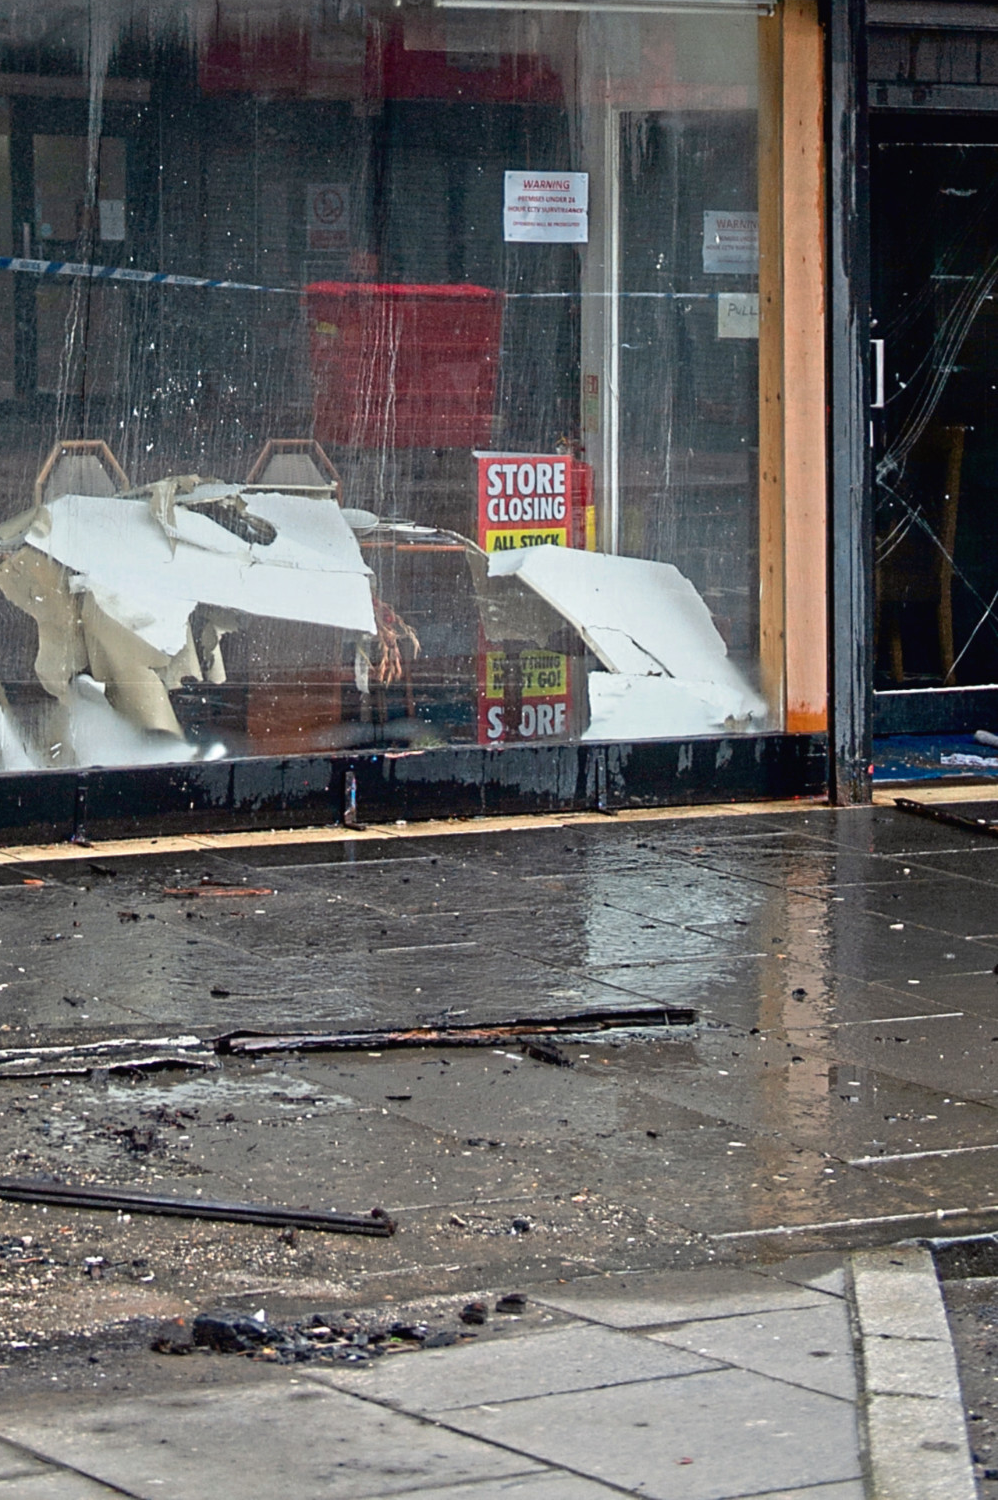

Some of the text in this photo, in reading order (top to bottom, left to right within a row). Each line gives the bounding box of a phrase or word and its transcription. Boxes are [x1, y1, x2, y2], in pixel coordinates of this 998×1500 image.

[522, 179, 571, 192] WARNING
[545, 196, 567, 204] UNDER
[507, 205, 526, 213] HOUR
[716, 218, 759, 231] WARNIN
[727, 302, 758, 317] PULL
[486, 462, 566, 496] STORE
[486, 497, 566, 522] CLOSING
[493, 532, 560, 552] ALL STOCK
[537, 670, 562, 688] GO!
[486, 702, 567, 740] SORE
